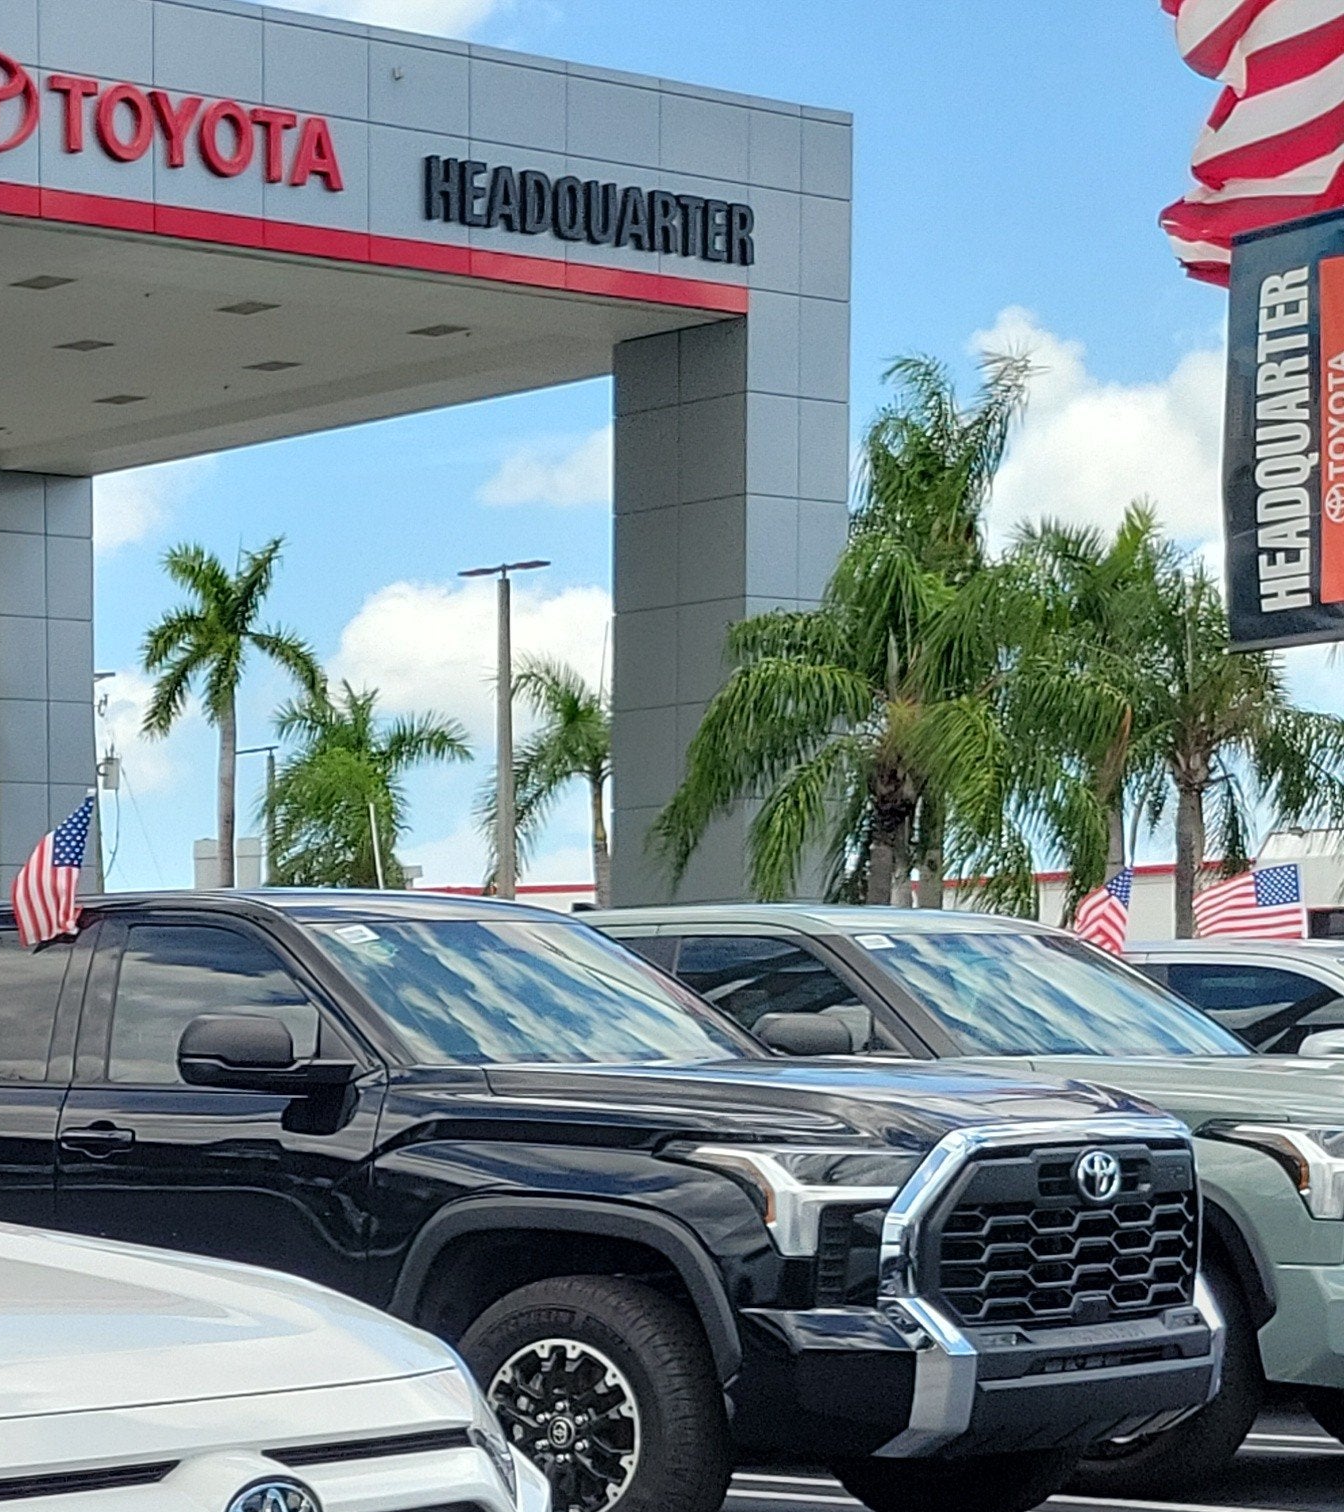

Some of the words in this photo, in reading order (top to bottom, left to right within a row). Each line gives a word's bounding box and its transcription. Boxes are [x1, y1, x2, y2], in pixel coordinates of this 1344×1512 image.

[48, 74, 344, 192] TOYOTA
[424, 155, 755, 266] HEADQUARTER
[1254, 265, 1319, 613] HEADQUARTER
